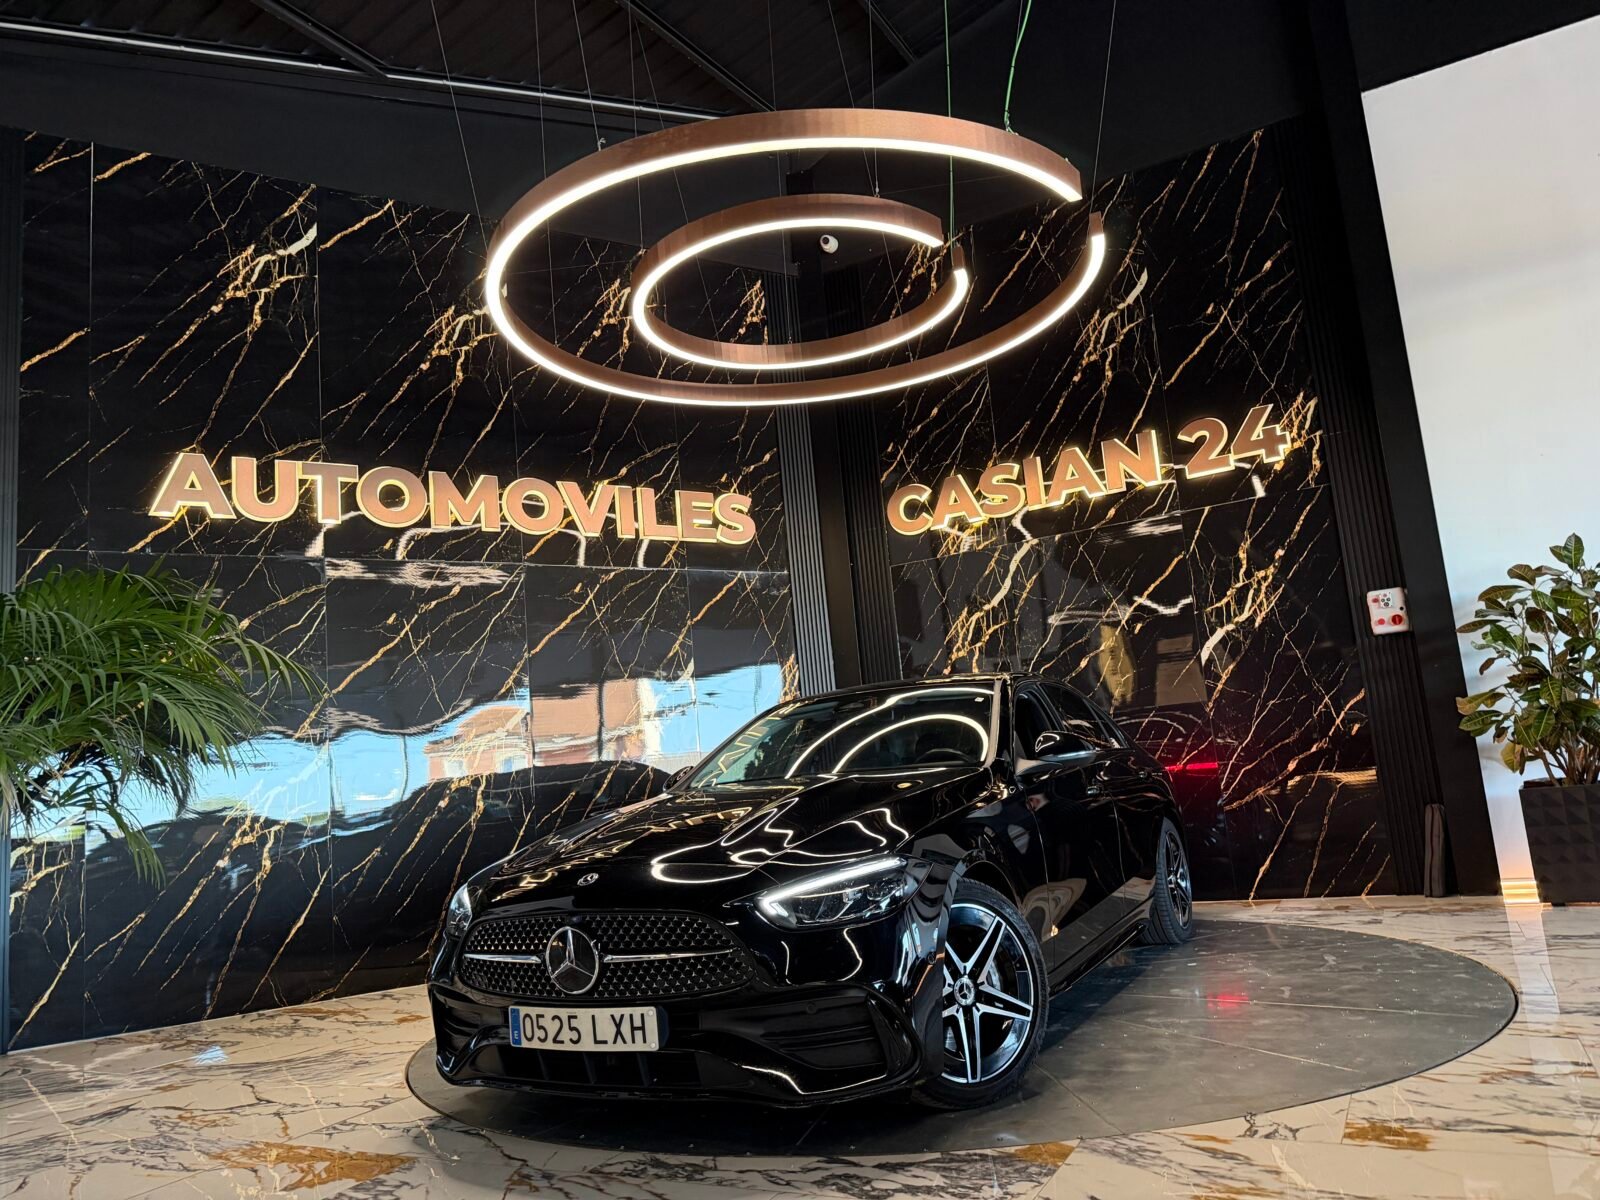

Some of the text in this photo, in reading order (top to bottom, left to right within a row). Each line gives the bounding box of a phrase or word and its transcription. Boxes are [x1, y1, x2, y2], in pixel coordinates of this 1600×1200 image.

[149, 452, 756, 545] AUTOMOVILES
[886, 404, 1292, 535] CASIAN 24
[522, 1013, 647, 1045] 0525 LXH
